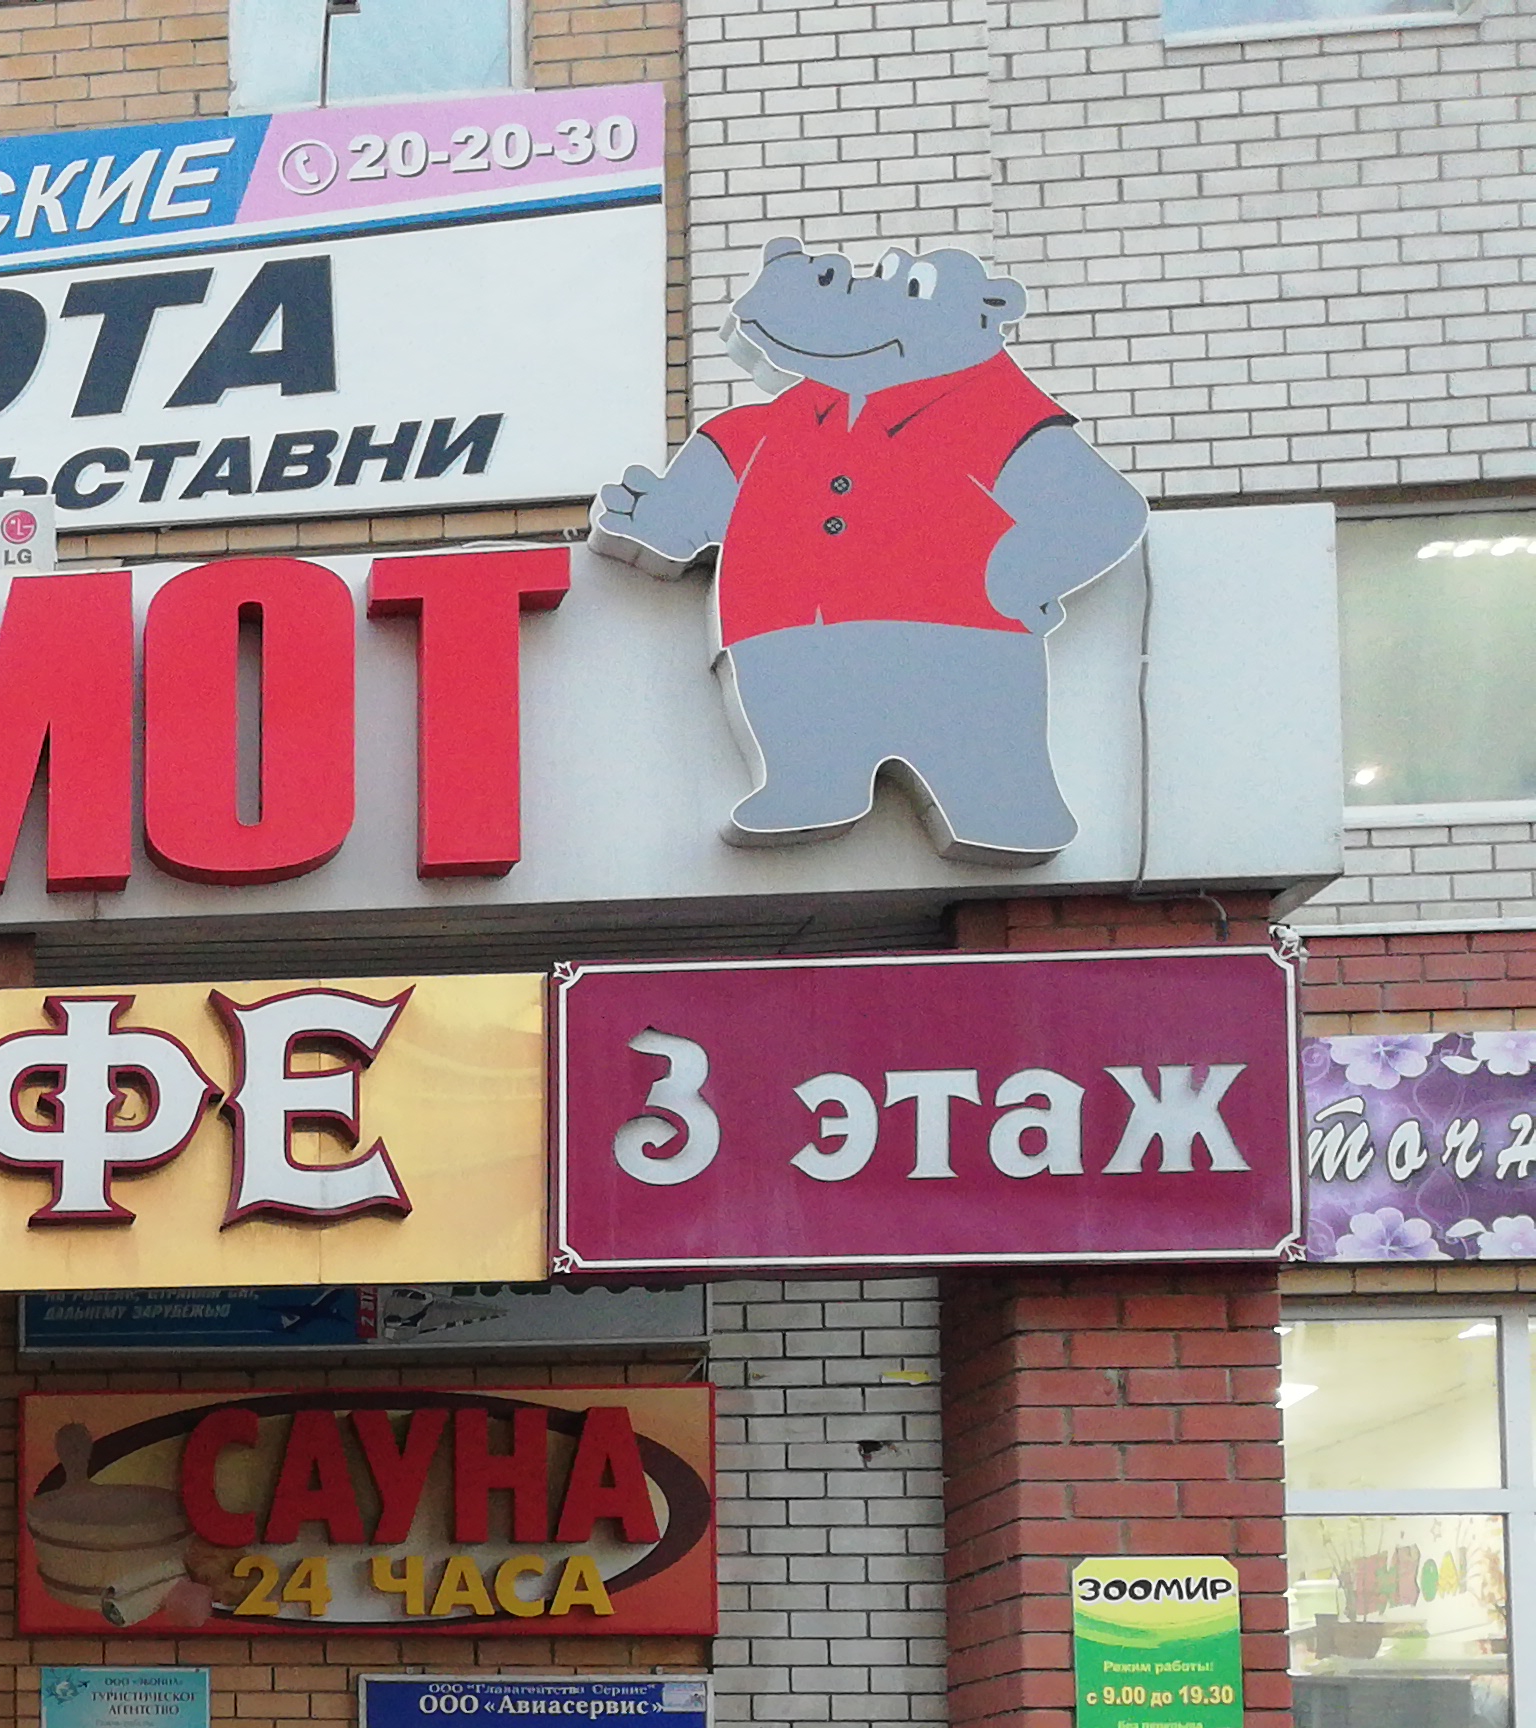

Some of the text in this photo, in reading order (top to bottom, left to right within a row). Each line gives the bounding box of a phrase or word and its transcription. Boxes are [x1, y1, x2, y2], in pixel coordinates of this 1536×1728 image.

[346, 114, 638, 182] 20-20-30
[3, 548, 33, 566] LG
[613, 1025, 1253, 1187] 3 этаж
[179, 1405, 660, 1548] САУНА
[232, 1555, 615, 1617] 24 ЧАСА
[1077, 1575, 1233, 1603] ЗООМИР
[1103, 1660, 1152, 1673] Режим
[428, 1684, 464, 1694] ООО
[1086, 1685, 1234, 1708] с 9.00 до 19.30
[418, 1694, 664, 1719] ООО «Авиасервис»
